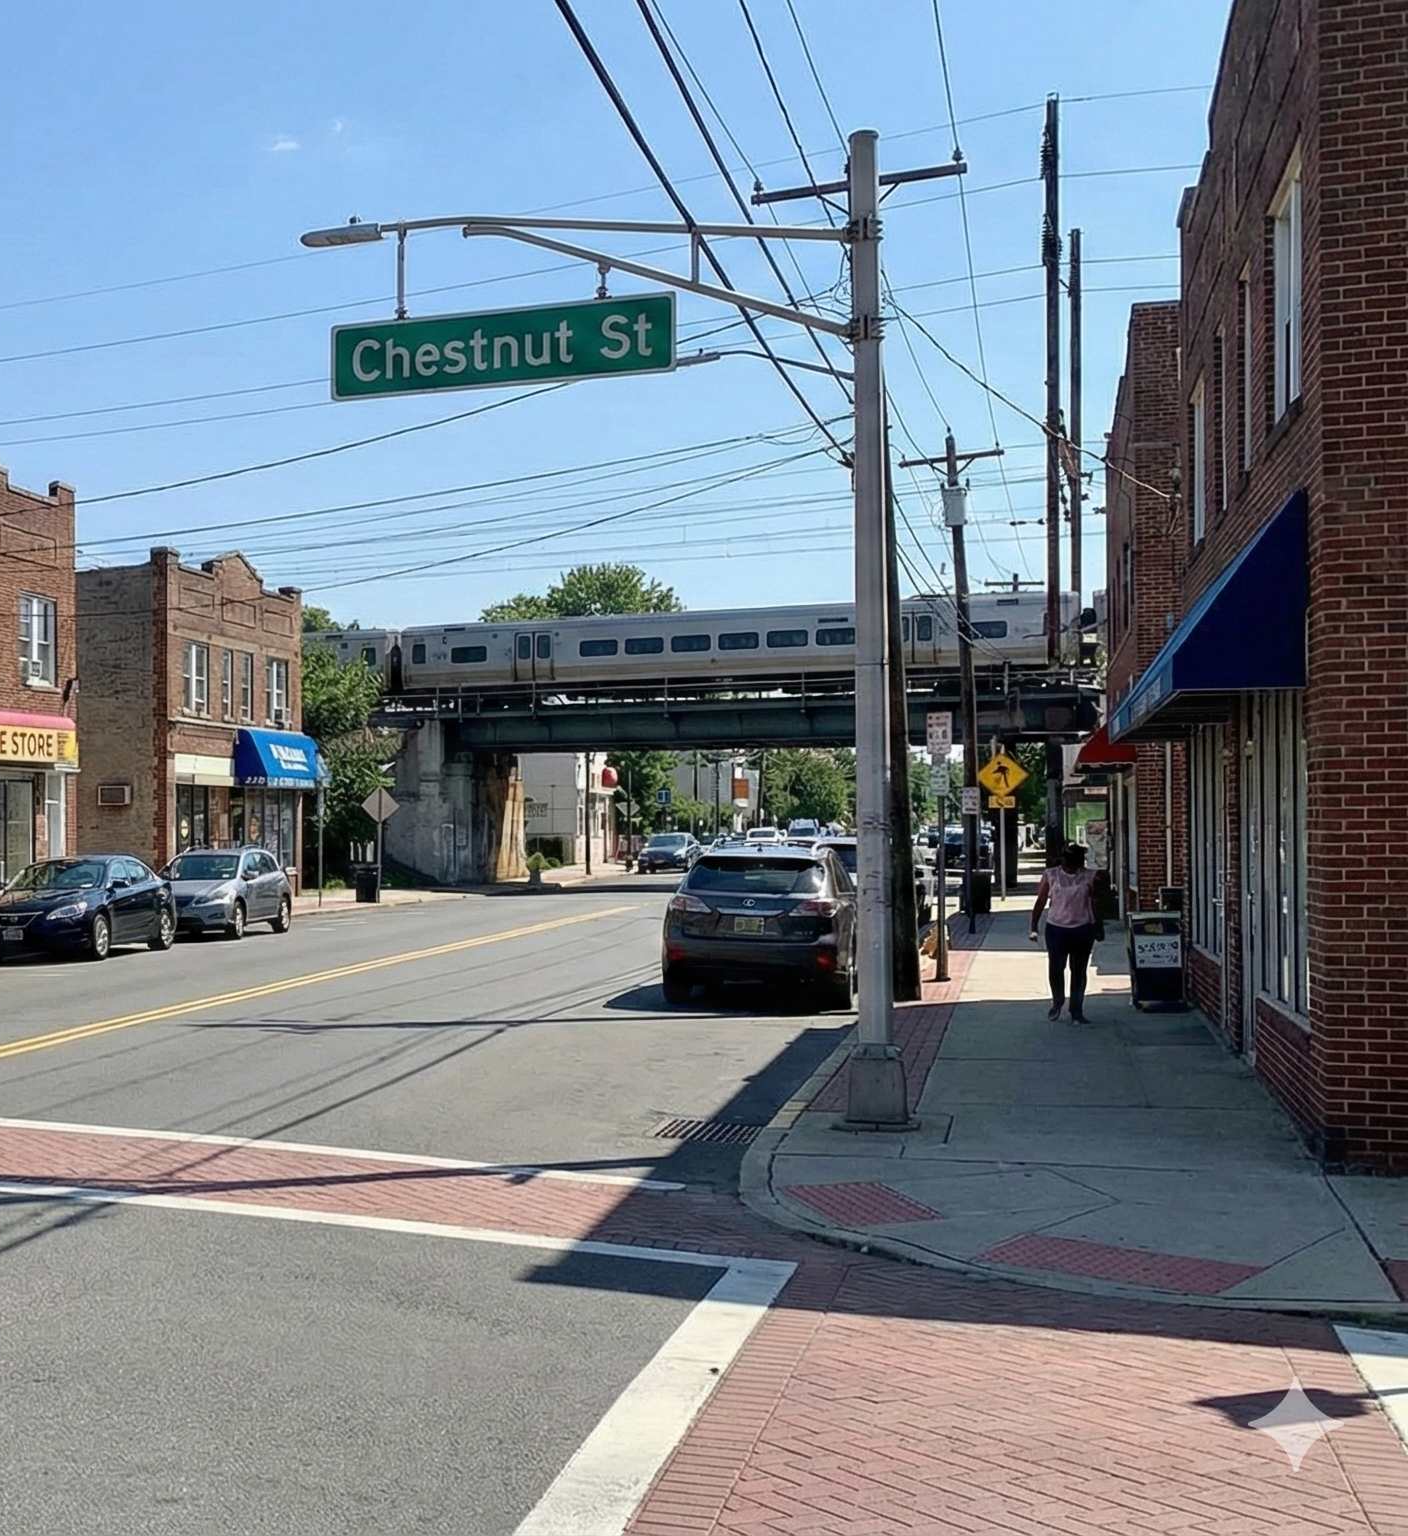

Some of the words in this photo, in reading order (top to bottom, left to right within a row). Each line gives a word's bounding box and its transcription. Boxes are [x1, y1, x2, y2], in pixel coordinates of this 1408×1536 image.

[352, 320, 573, 382] Chestnut
[600, 312, 652, 360] St
[11, 731, 53, 757] STORE
